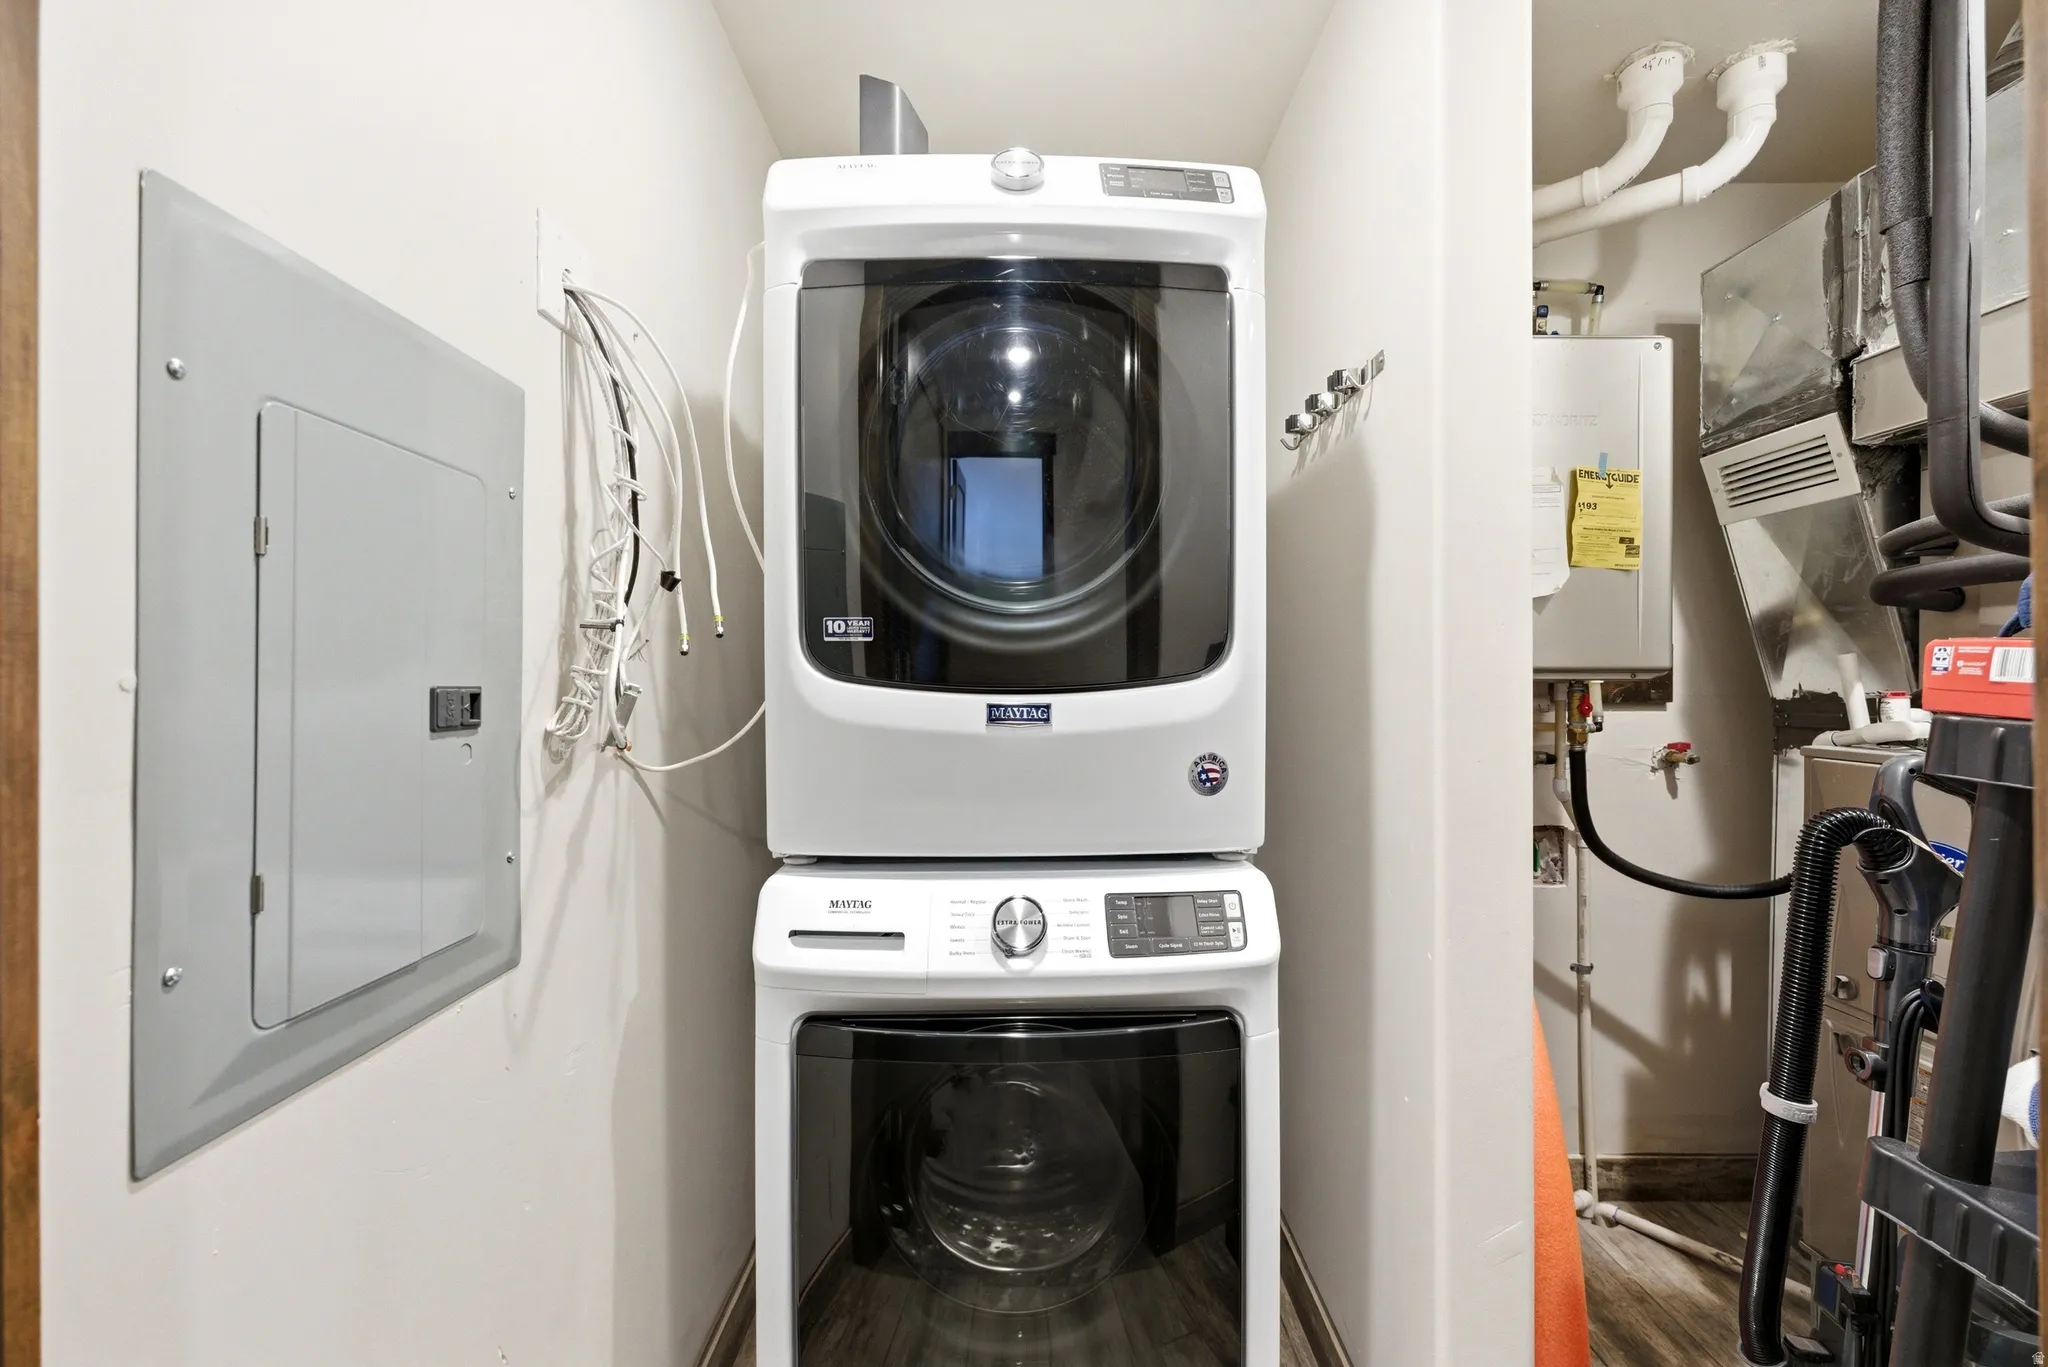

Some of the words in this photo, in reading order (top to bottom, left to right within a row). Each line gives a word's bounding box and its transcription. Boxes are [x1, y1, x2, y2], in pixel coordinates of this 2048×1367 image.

[1578, 501, 1598, 511] $193
[826, 620, 846, 634] 10
[990, 707, 1049, 719] MAYTAG
[1193, 753, 1227, 774] AMERICA
[829, 899, 872, 909] MAYTAG
